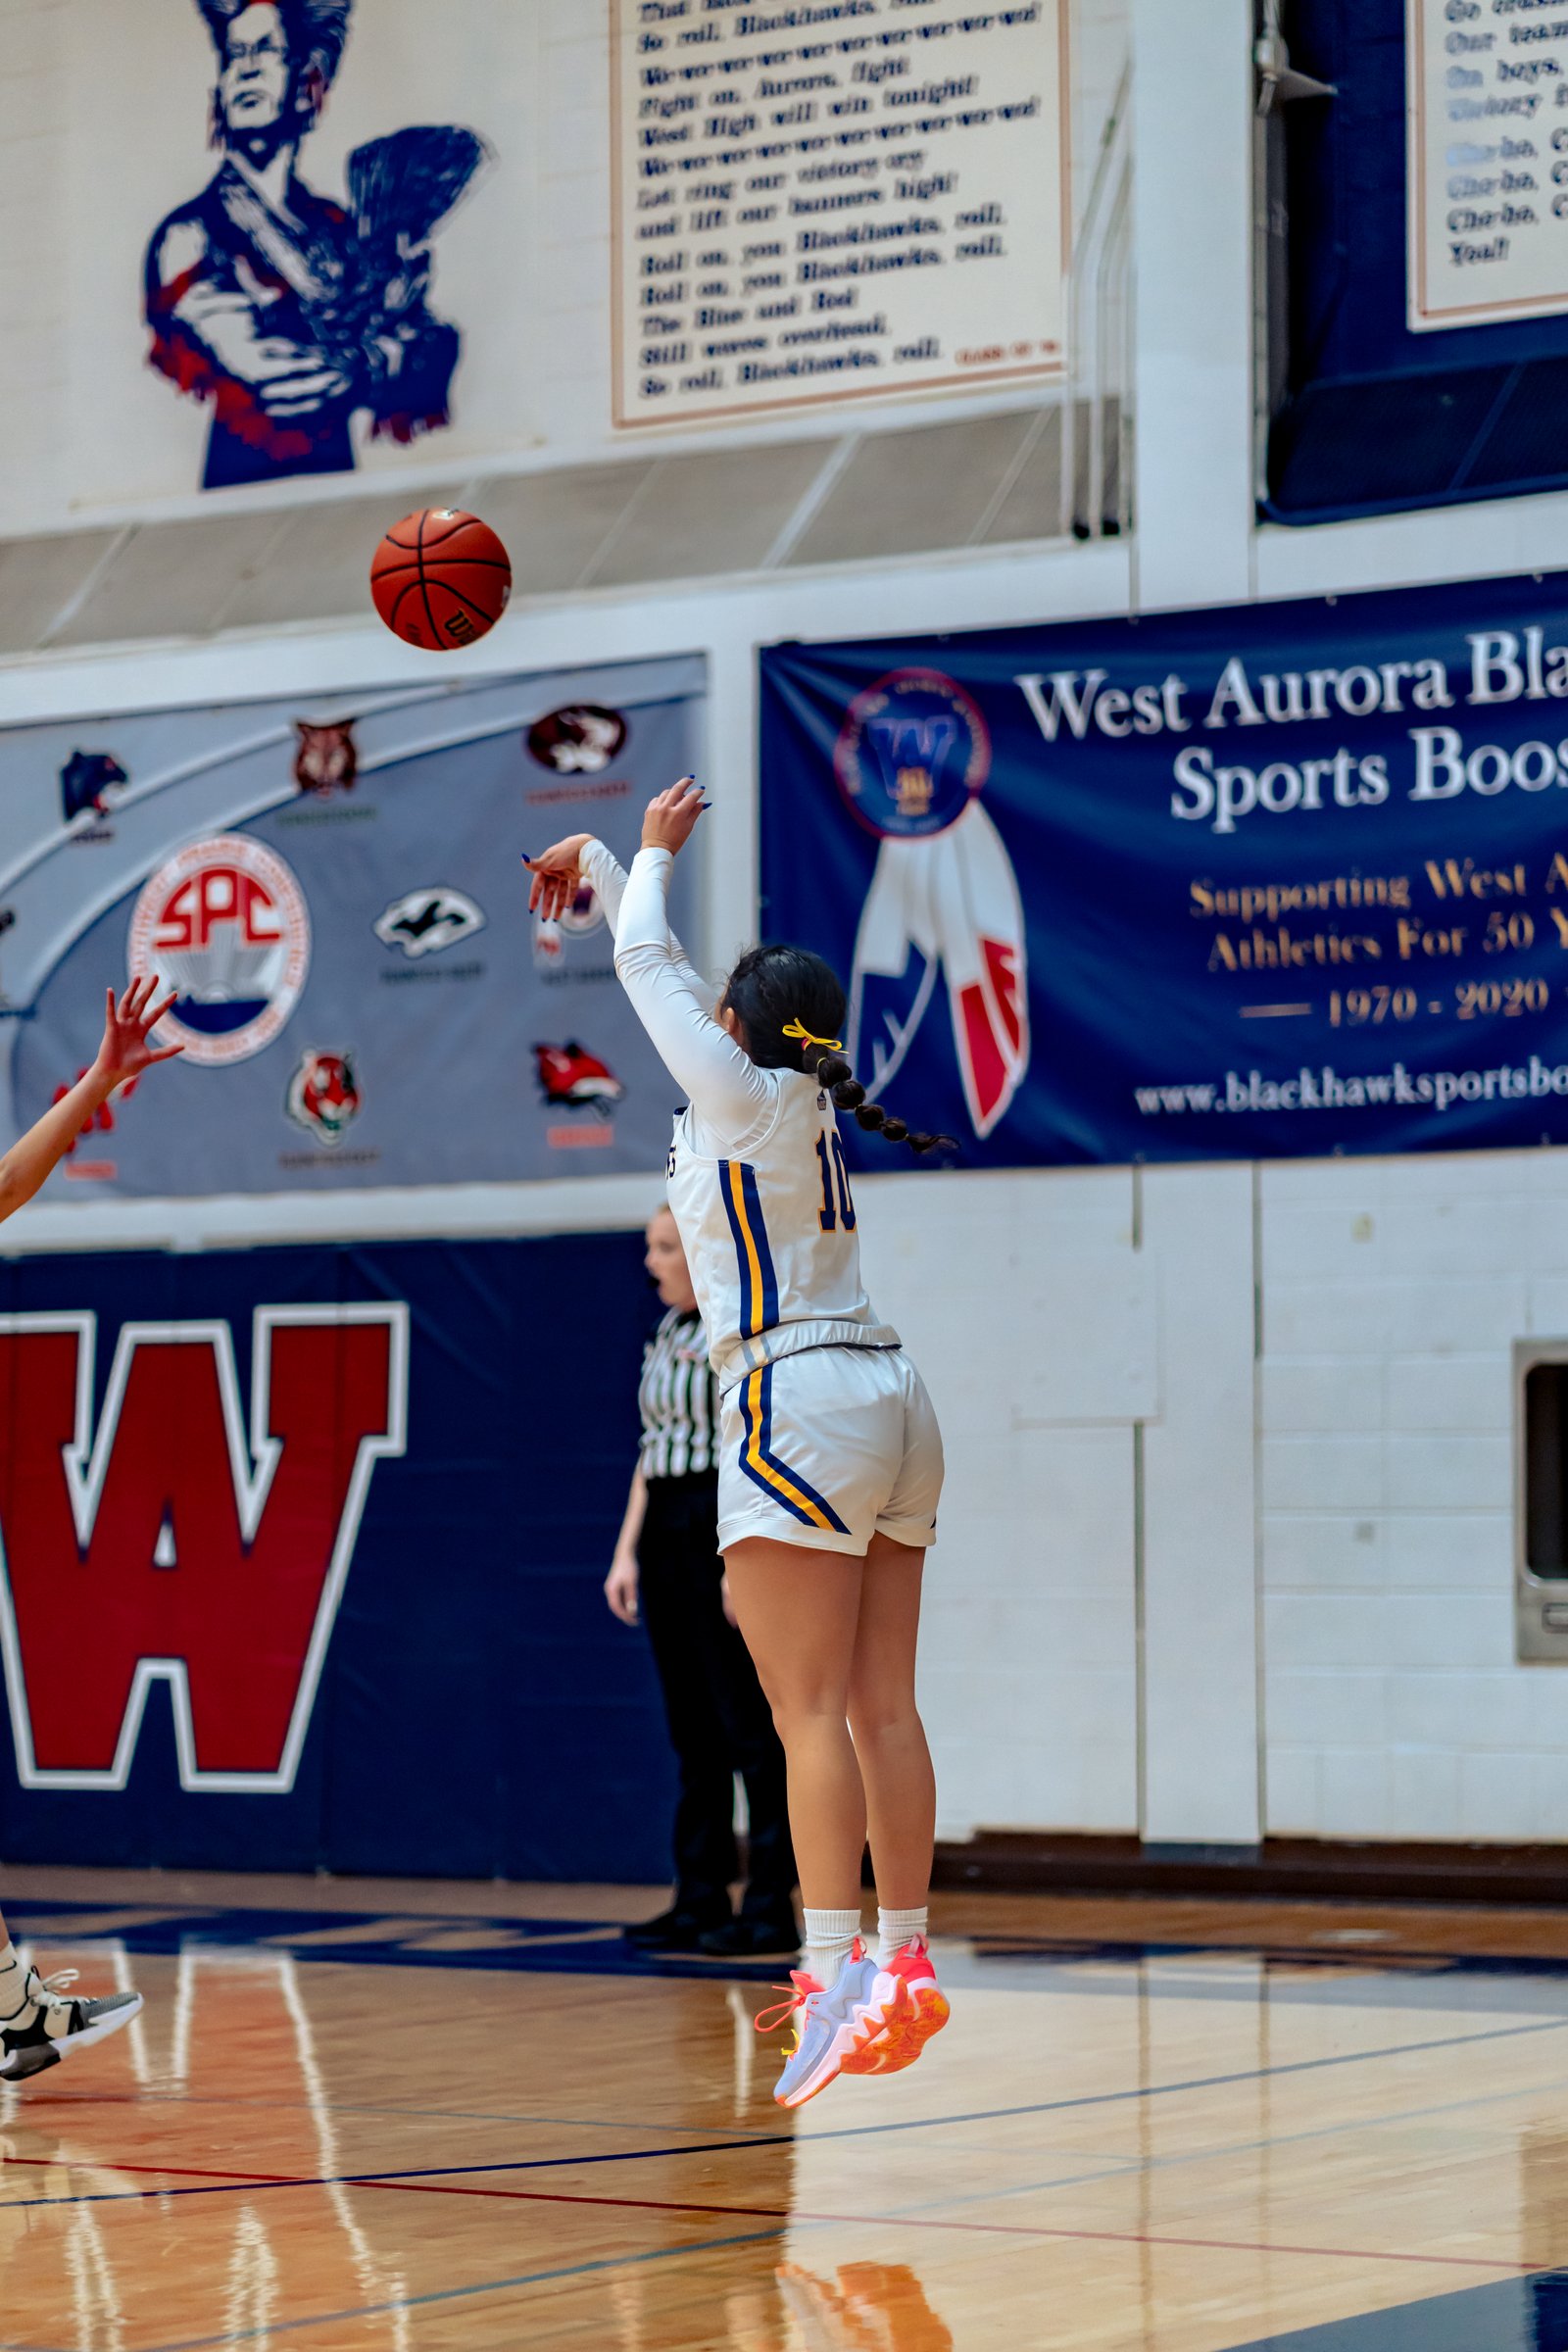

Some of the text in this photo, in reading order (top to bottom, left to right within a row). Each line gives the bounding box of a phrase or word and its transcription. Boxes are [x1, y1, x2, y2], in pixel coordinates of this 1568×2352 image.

[1015, 668, 1192, 742] West
[1203, 656, 1454, 729] Aurora
[1171, 746, 1390, 834] Sports
[154, 866, 283, 951] SPC
[1189, 866, 1411, 924] Supporting
[1425, 856, 1528, 901] West
[1207, 923, 1383, 972] Athletics
[1396, 917, 1469, 960] For
[1482, 910, 1536, 955] 50
[1329, 984, 1419, 1029] 1970
[1455, 977, 1549, 1020] 2020
[815, 1128, 857, 1233] 10
[0, 1301, 409, 1793] W
